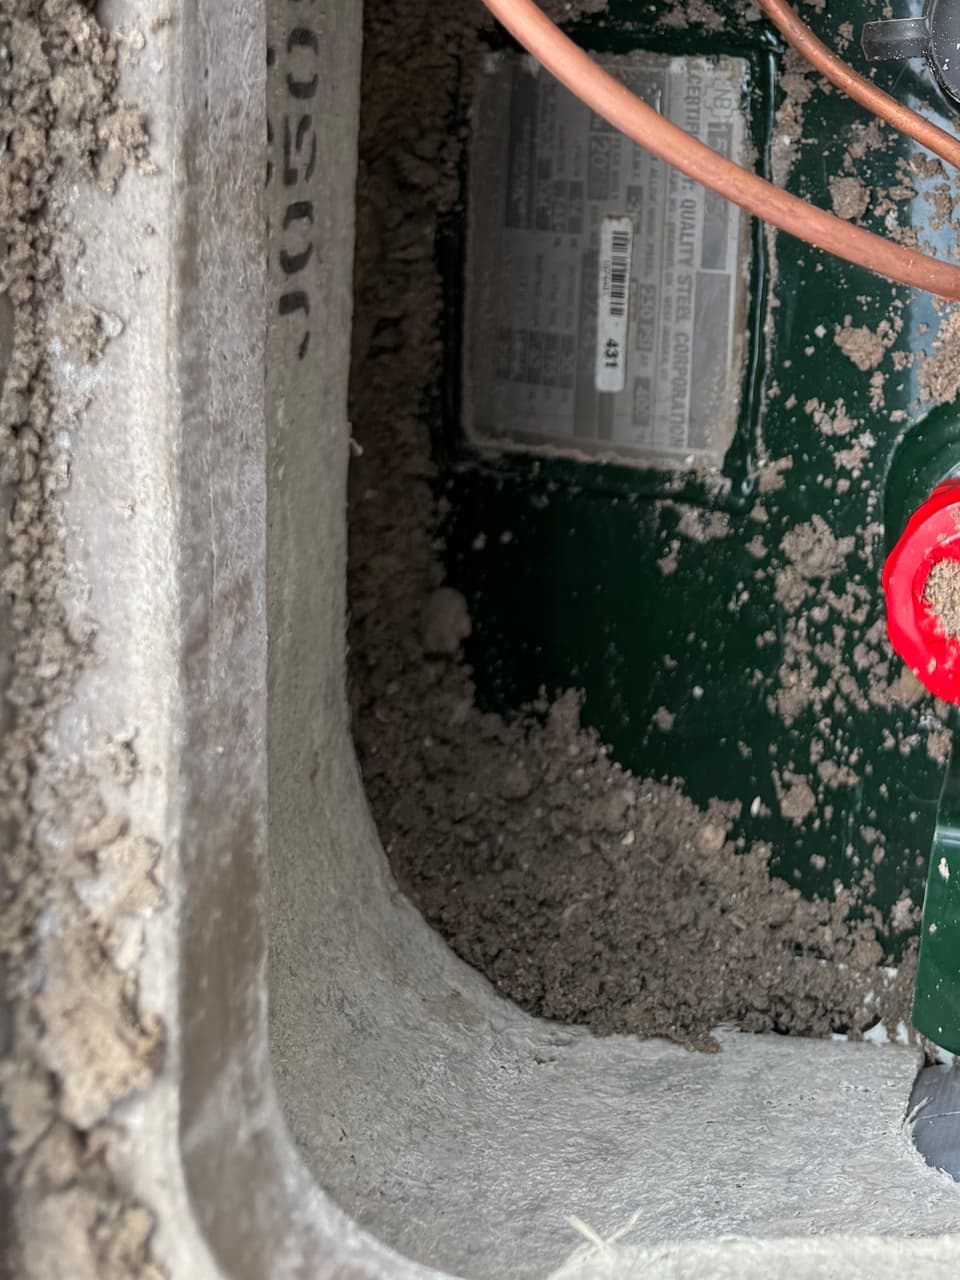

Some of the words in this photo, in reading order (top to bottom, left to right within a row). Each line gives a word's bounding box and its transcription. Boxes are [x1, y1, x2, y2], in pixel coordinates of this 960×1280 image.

[676, 199, 698, 267] QUALITY
[673, 273, 693, 322] STEEL
[605, 337, 619, 369] 431
[669, 332, 690, 448] CORPORATION
